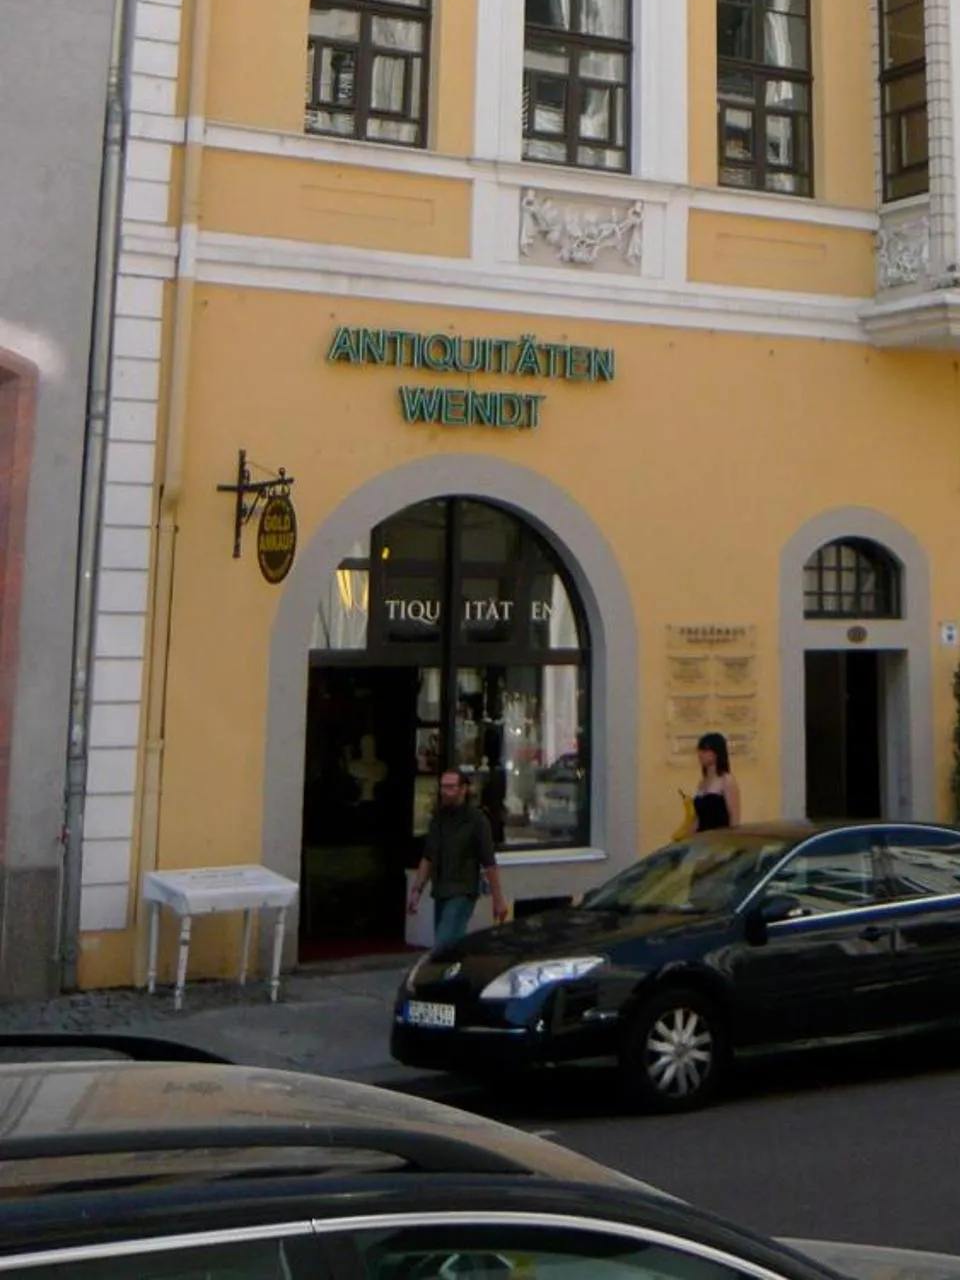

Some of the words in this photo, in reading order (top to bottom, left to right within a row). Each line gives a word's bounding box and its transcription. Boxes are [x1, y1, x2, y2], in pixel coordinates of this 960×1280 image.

[327, 326, 616, 381] ANTIQUITÄTEN
[398, 385, 547, 428] WENDT
[263, 514, 292, 532] GOLD
[385, 600, 441, 625] TIQU
